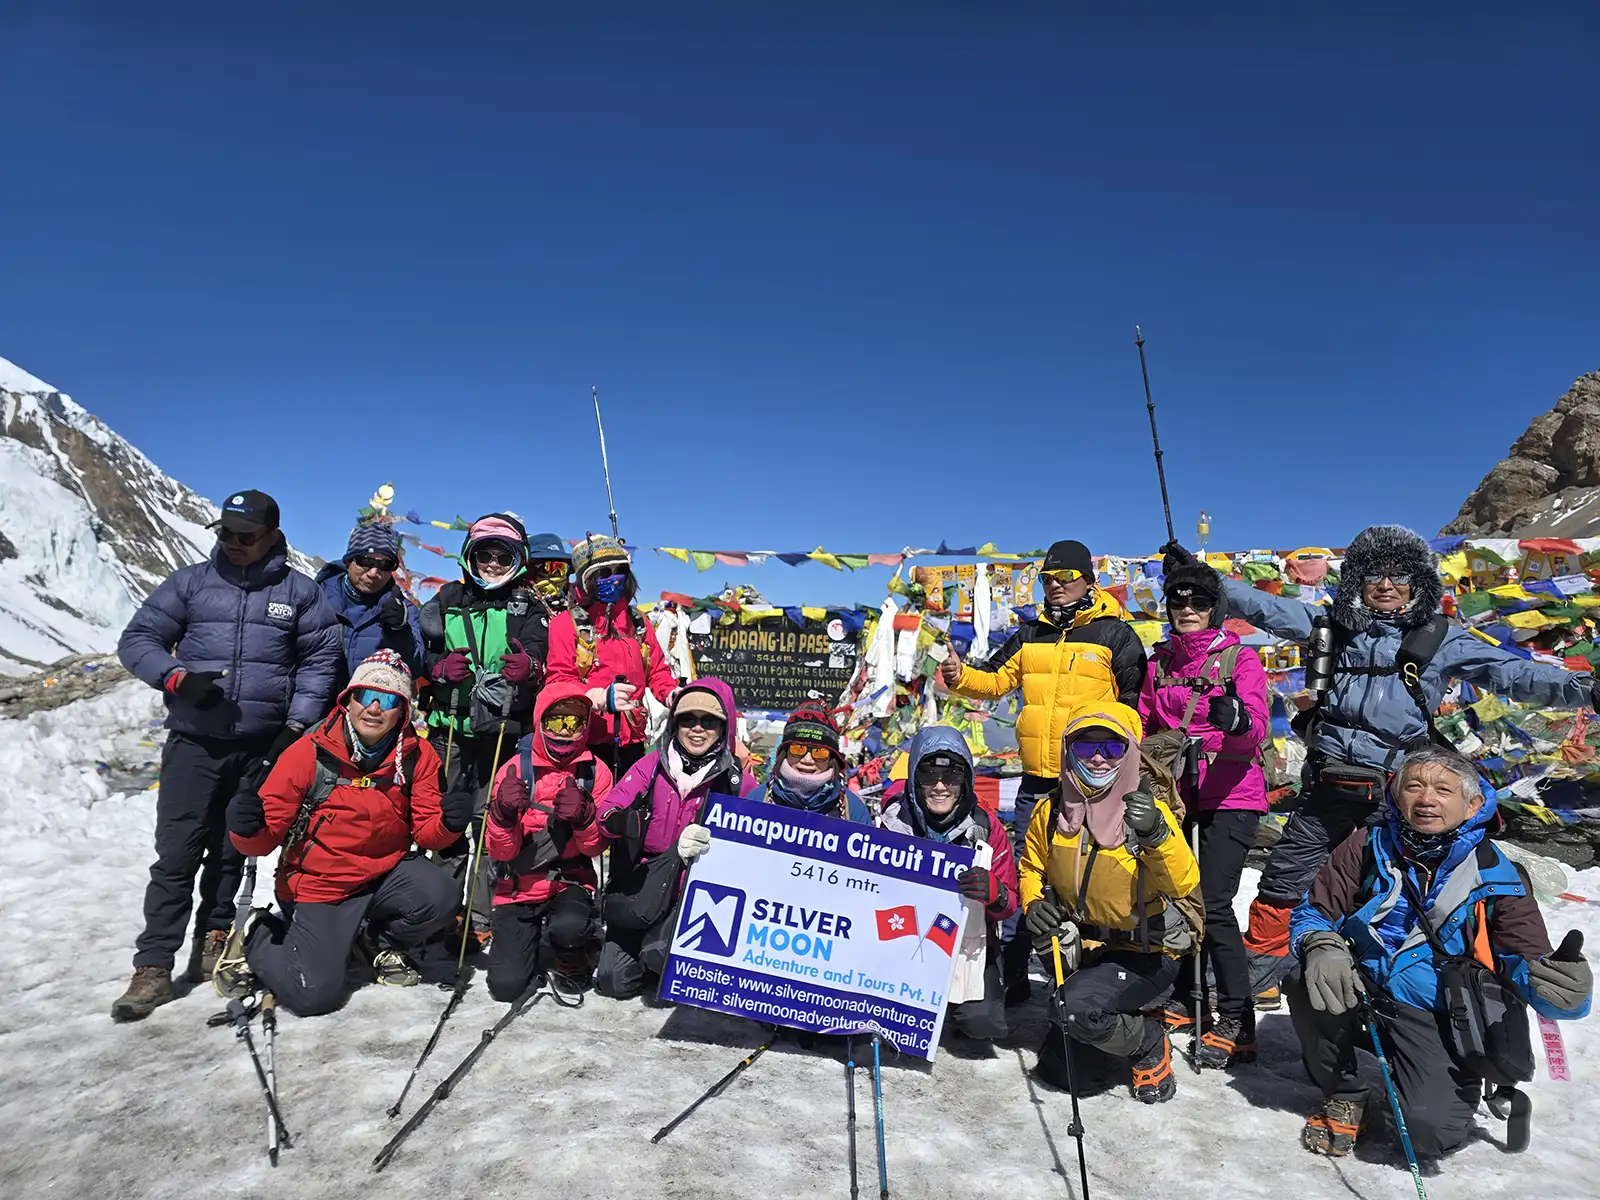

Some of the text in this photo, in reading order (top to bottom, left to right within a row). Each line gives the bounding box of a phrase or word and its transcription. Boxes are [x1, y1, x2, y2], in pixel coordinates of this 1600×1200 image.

[268, 605, 293, 617] CATCH
[799, 633, 830, 654] PASS
[755, 653, 782, 663] 5416
[696, 662, 852, 679] NGRATULATION FOR THE SUCCESS
[759, 677, 775, 687] THE
[779, 678, 800, 688] TREK
[751, 688, 772, 698] YOU
[704, 803, 970, 881] Annapurna Circuit Tre
[790, 861, 880, 894] 5416 mtr.
[751, 898, 852, 940] SILVER
[745, 923, 833, 962] MOON
[742, 948, 819, 978] Adventure
[823, 969, 853, 985] and
[857, 972, 895, 994] Tours
[900, 982, 925, 1003] Pvt.
[670, 979, 719, 1003] E-mail:
[675, 960, 935, 1033] Website: www.silvermoonadventure.co
